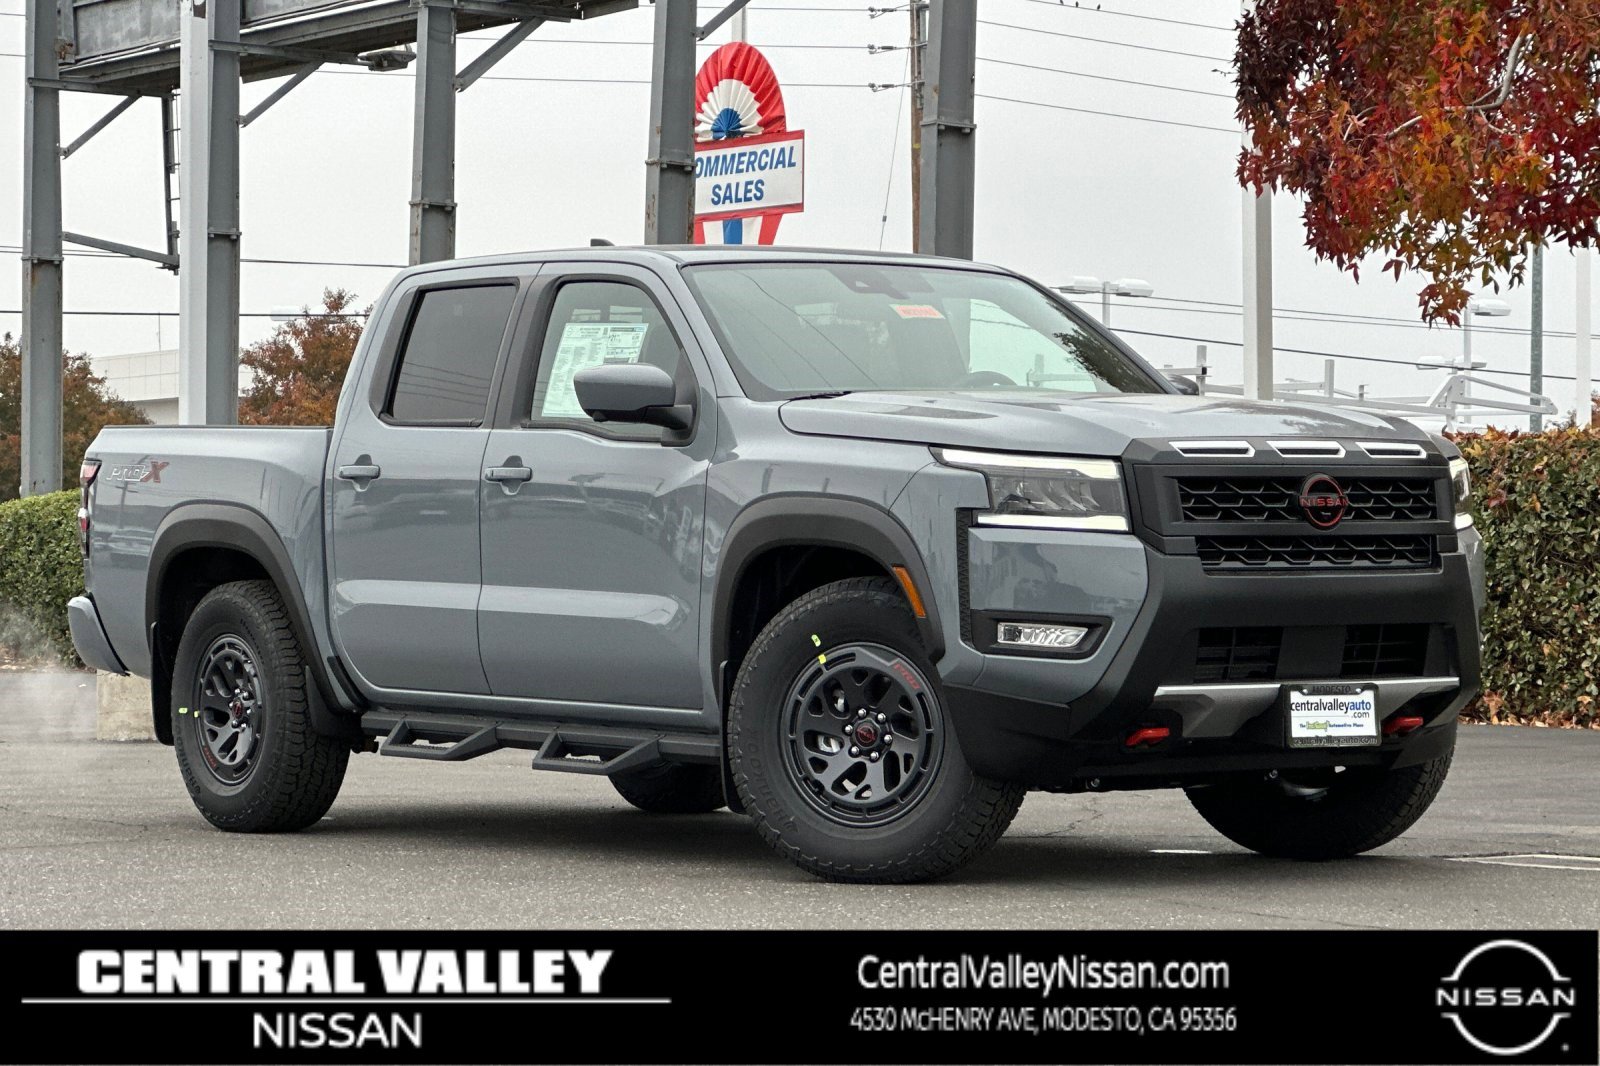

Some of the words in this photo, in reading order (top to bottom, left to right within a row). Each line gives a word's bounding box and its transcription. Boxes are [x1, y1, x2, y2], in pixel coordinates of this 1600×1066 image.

[695, 145, 797, 179] OMMERCIAL
[711, 179, 765, 206] SALES
[1300, 496, 1350, 508] NISSAN
[1290, 698, 1372, 714] centralvalleyauto
[1351, 711, 1370, 719] .com
